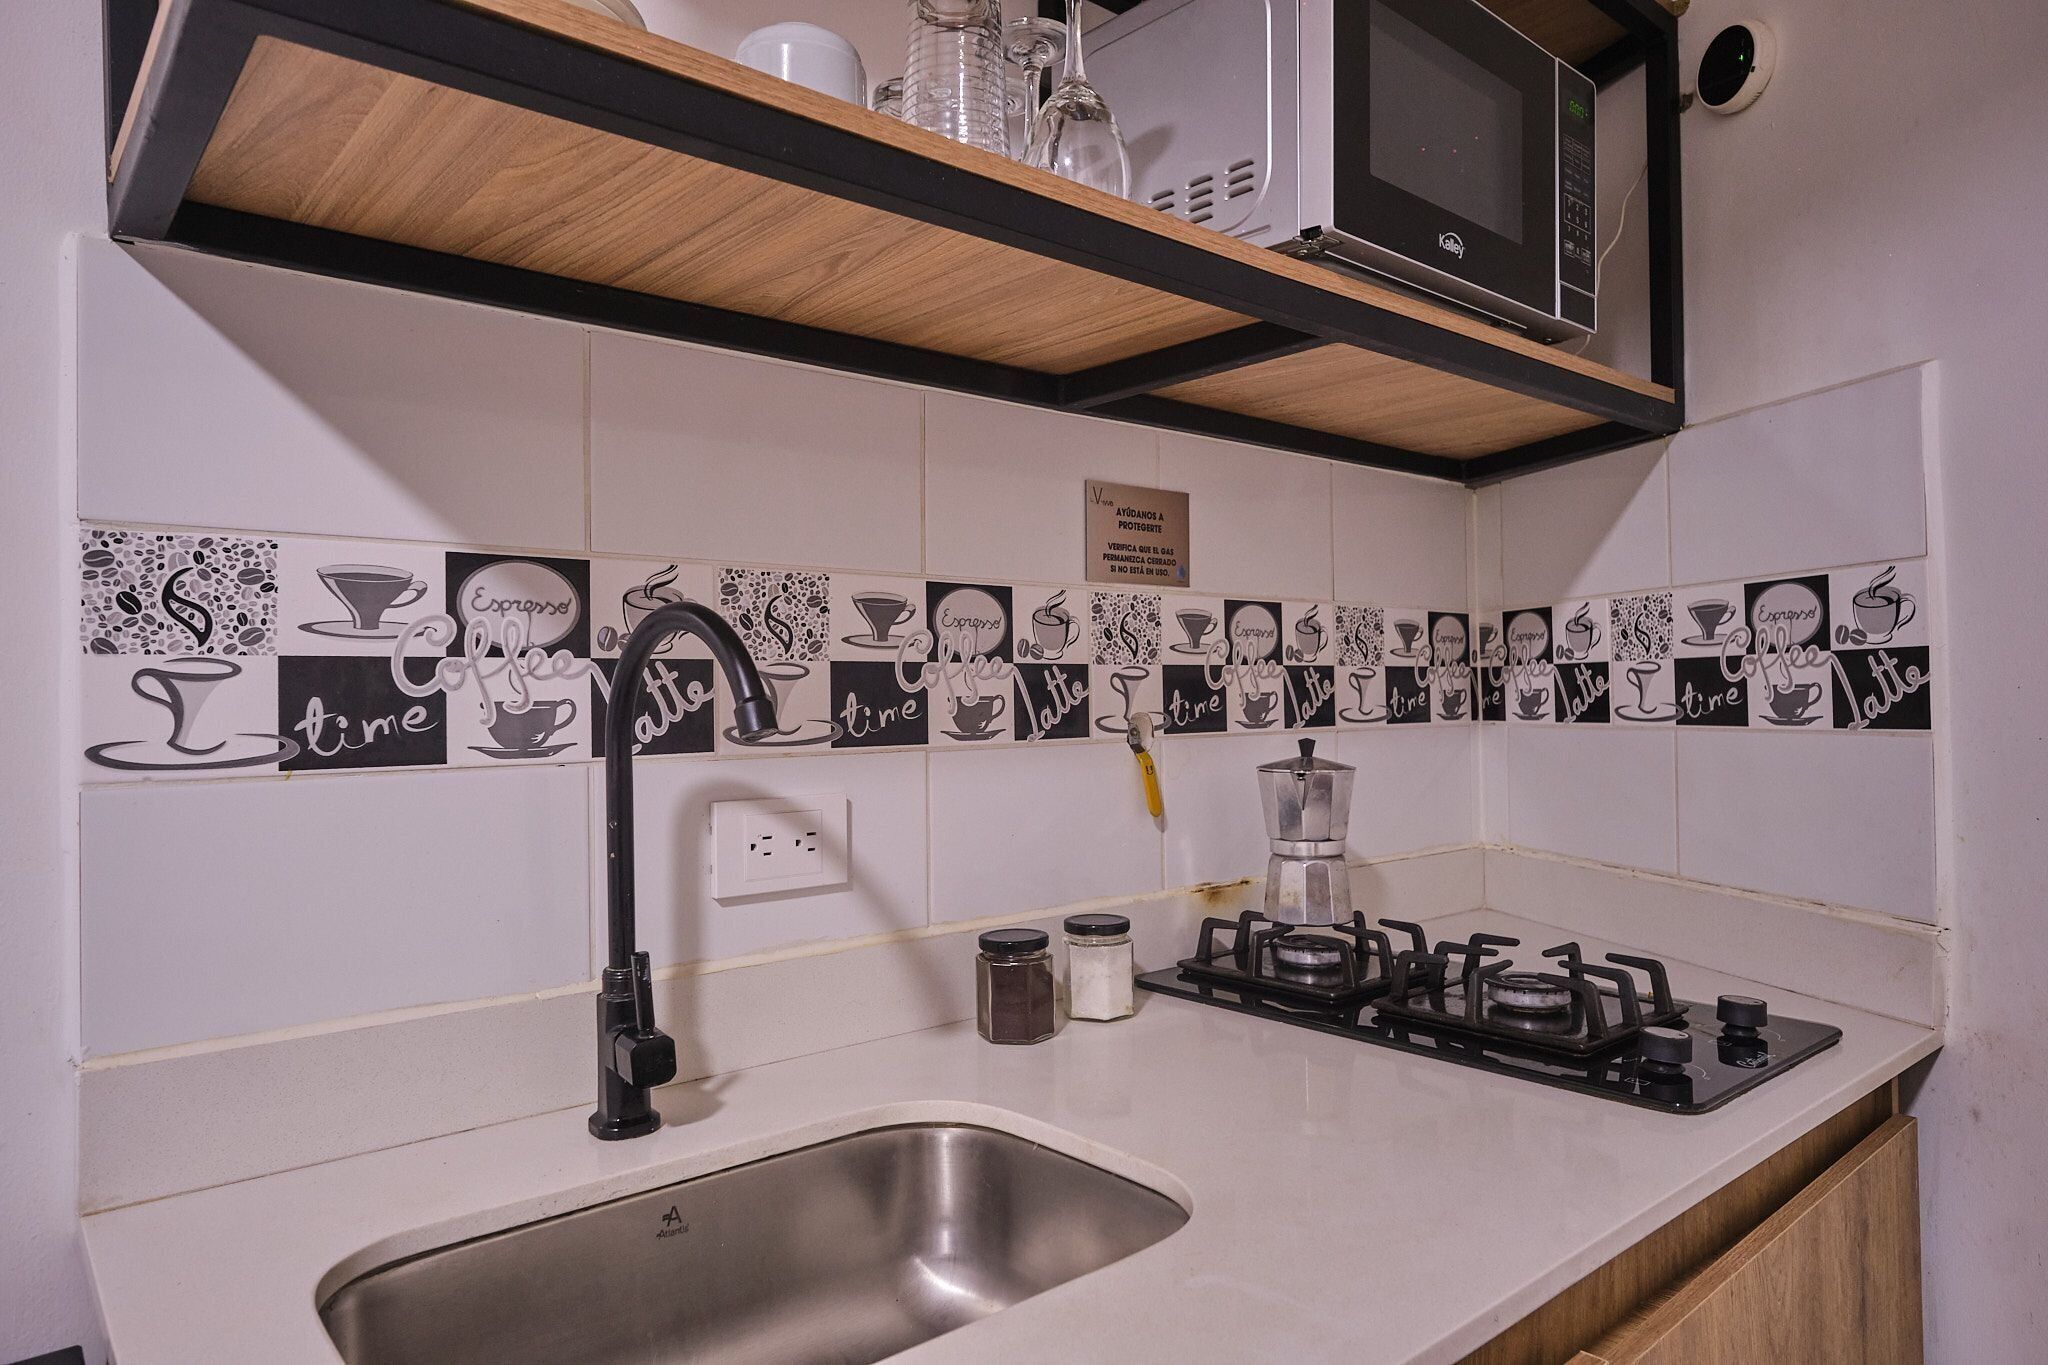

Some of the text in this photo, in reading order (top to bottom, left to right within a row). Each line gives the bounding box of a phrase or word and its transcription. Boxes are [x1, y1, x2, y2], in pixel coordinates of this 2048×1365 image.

[1438, 232, 1464, 259] Kalley
[1116, 507, 1165, 521] AYÚDANOS A
[1118, 520, 1162, 534] PROTEGERTE
[1102, 552, 1177, 567] PERMANEZCA CERRADO
[1107, 542, 1174, 556] VERIFICA QUE EL GAS
[1110, 564, 1170, 577] SI NO ESTÁ EN USO.
[470, 587, 572, 617] Espresso
[1757, 605, 1818, 625] Espresso
[941, 607, 1002, 631] Espresso
[1234, 620, 1275, 639] Espresso
[1510, 629, 1546, 643] Espresso
[391, 613, 590, 728] Coffee
[895, 628, 1014, 717] Coffee
[1204, 638, 1284, 709] Coffee
[1488, 643, 1554, 703] Coffee
[1720, 624, 1832, 703] Coffee
[840, 692, 924, 738] time
[1168, 689, 1224, 726] time
[1389, 686, 1429, 718] time
[1681, 681, 1744, 719] time
[293, 696, 439, 757] time
